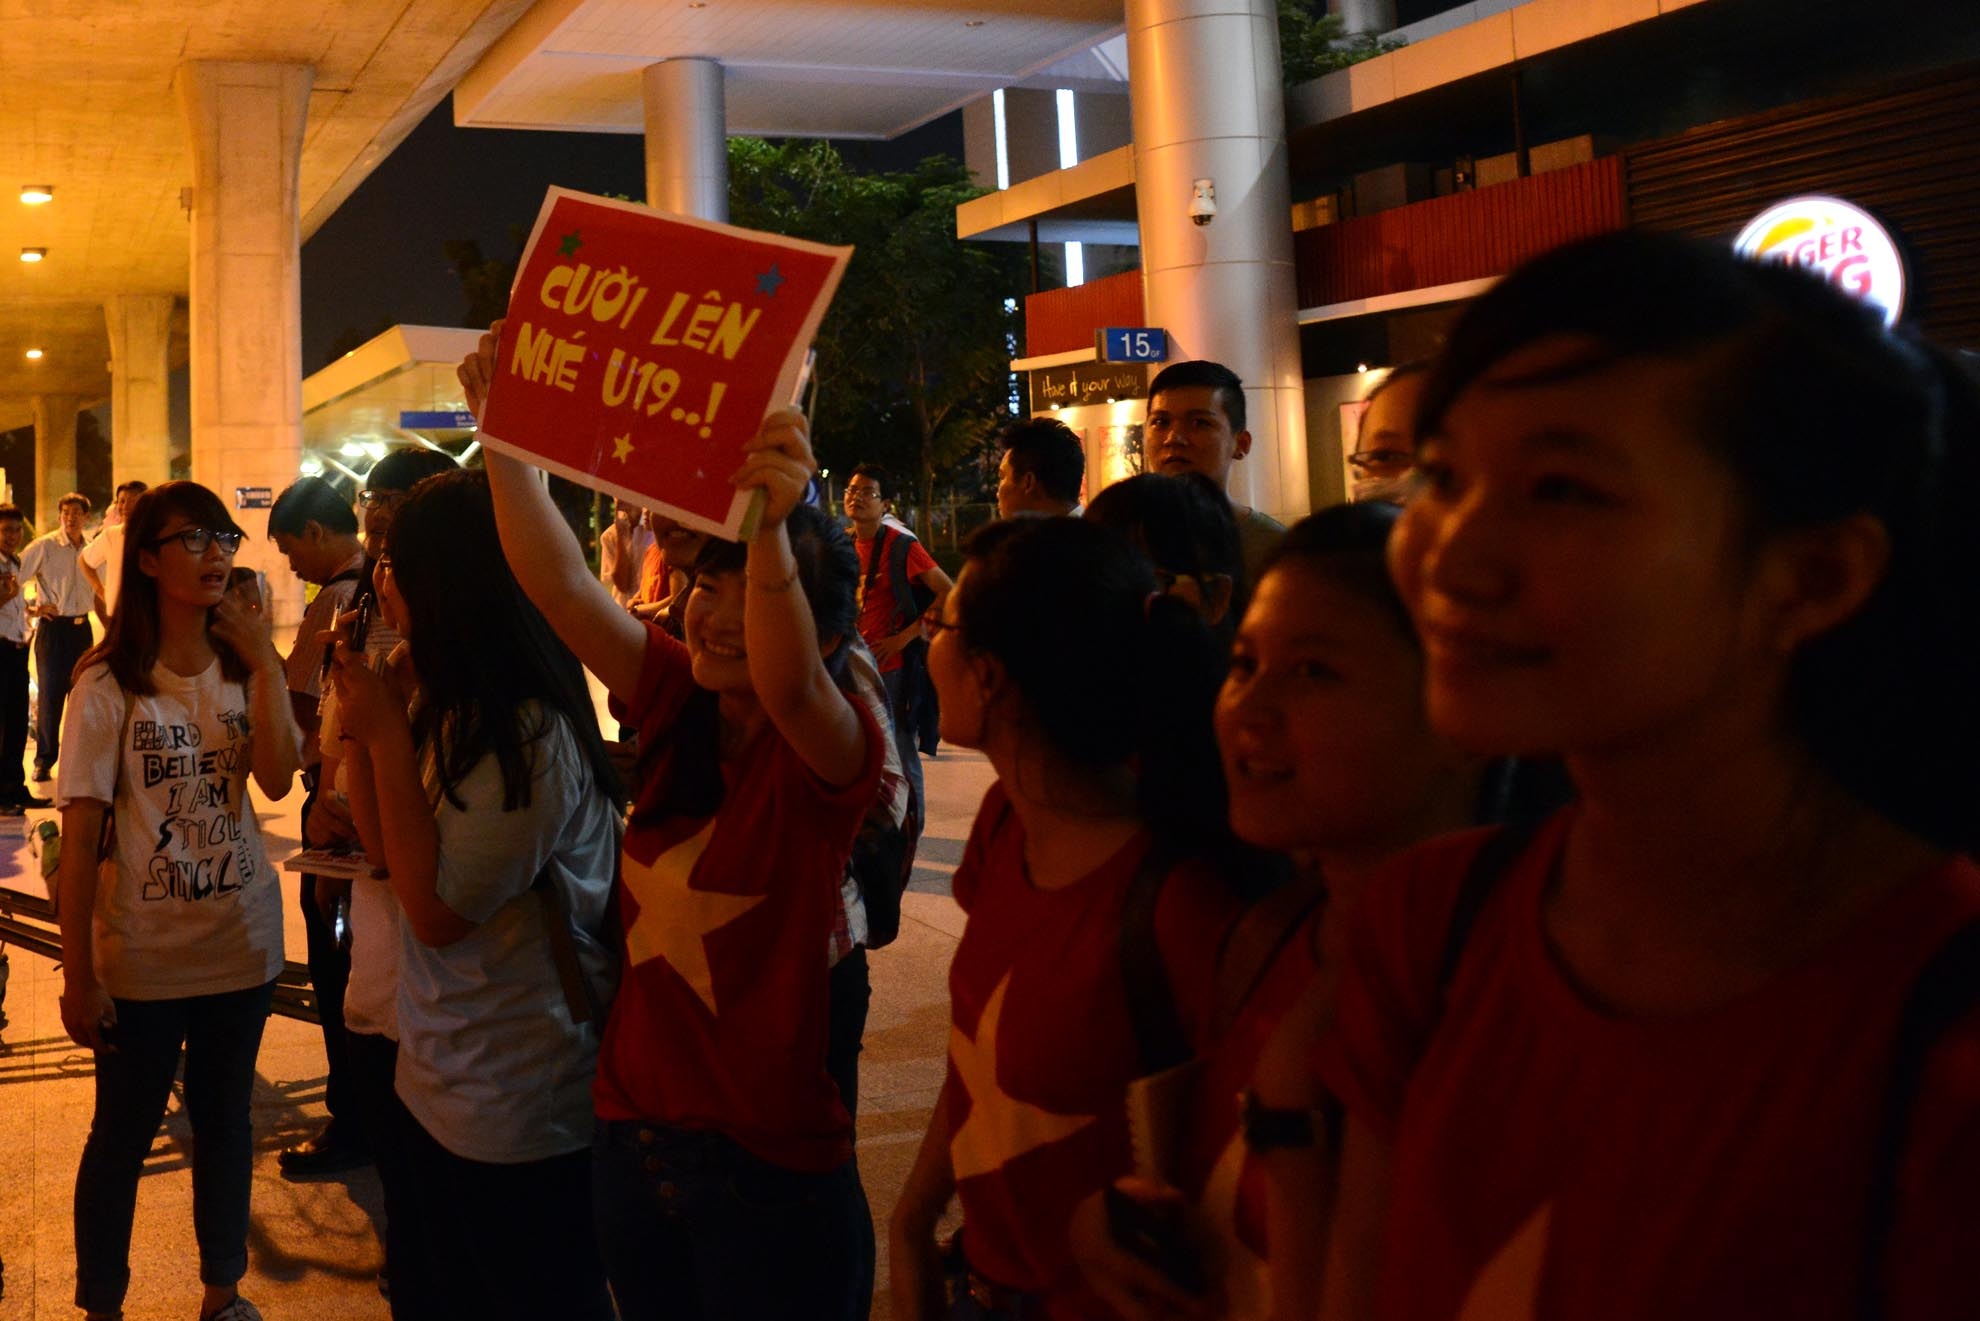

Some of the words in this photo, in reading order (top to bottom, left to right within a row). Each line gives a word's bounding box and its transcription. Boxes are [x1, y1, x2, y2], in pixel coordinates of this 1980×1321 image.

[541, 263, 648, 329] CƯỜI
[651, 290, 761, 360] LÊN
[511, 322, 586, 392] NHÉ
[1121, 333, 1150, 357] 15
[1042, 375, 1066, 398] Have
[1069, 371, 1079, 397] it
[1082, 378, 1111, 401] your
[133, 721, 202, 751] HARD
[166, 781, 187, 816] I
[189, 776, 230, 814] AM
